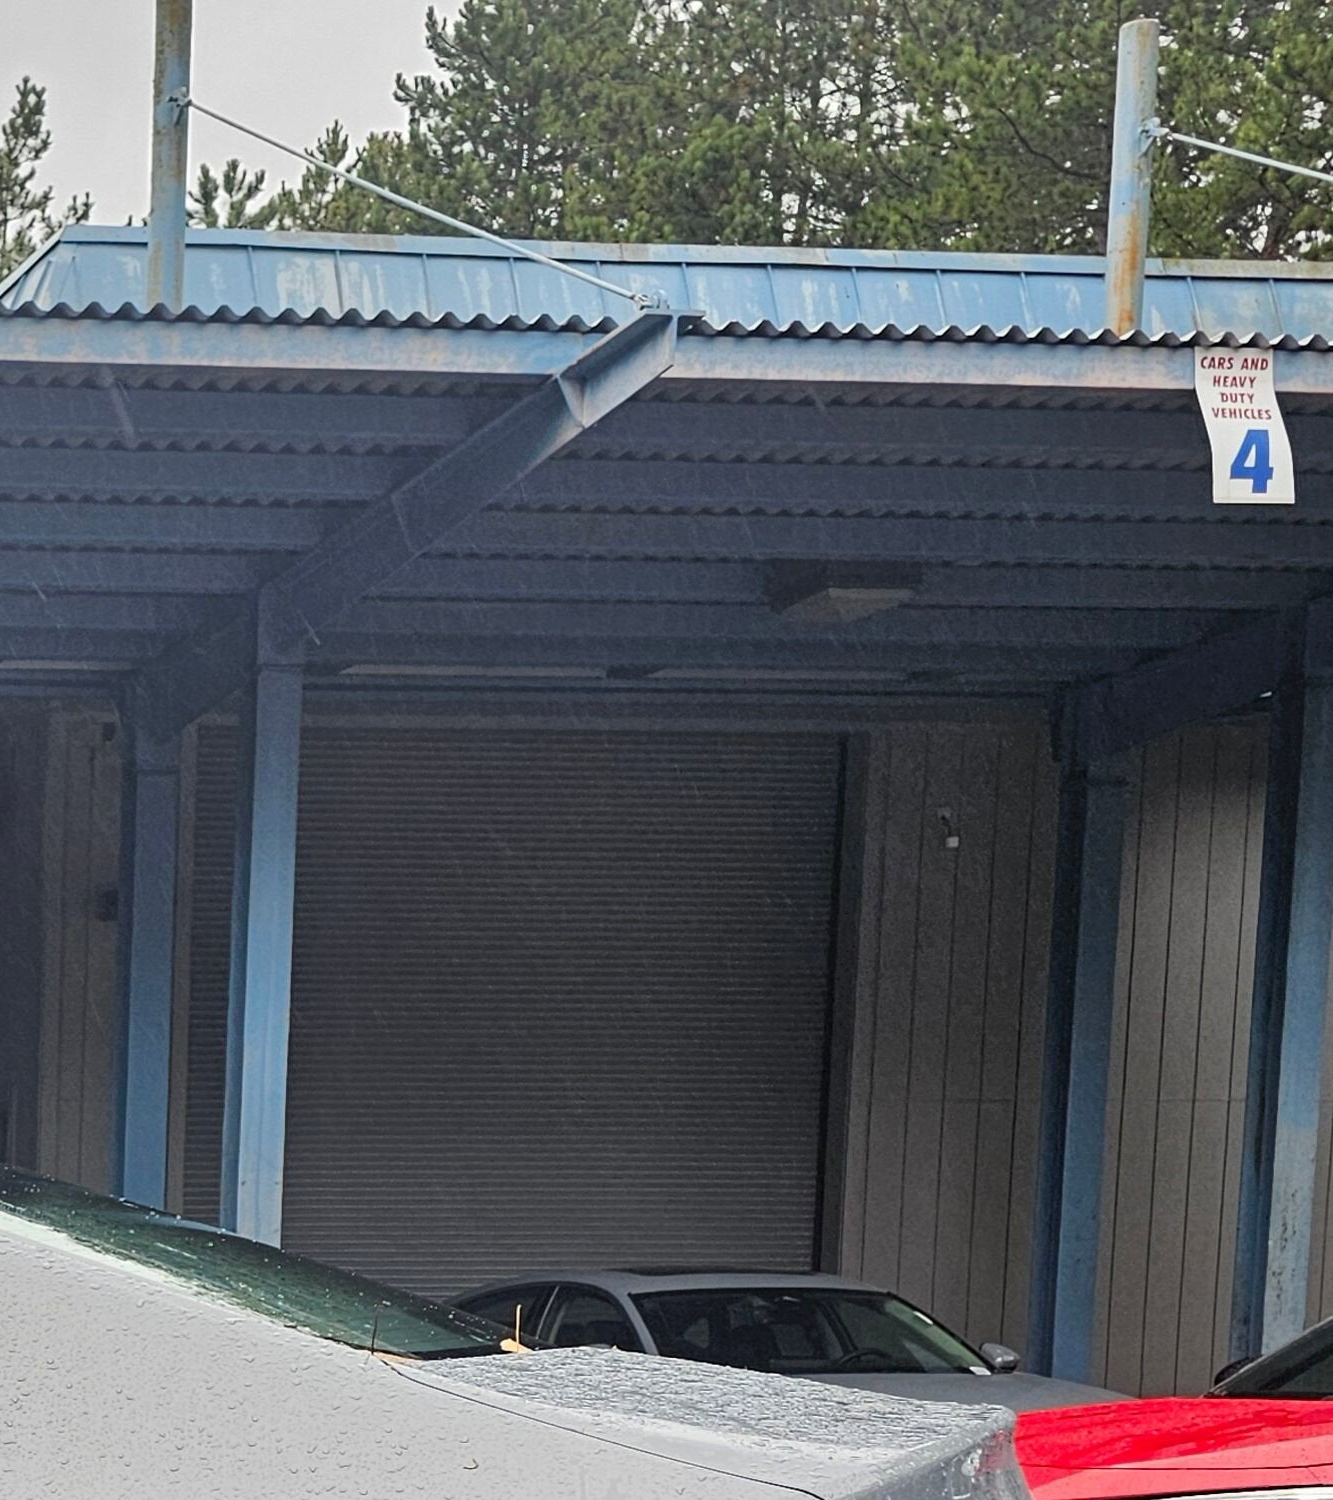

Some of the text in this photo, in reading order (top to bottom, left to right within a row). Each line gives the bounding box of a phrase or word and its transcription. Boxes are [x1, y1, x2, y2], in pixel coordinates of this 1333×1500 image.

[1200, 356, 1269, 371] CARS AND
[1212, 375, 1257, 389] HEAVY
[1220, 392, 1255, 404] DUTY
[1211, 407, 1272, 420] VEHICLES
[1229, 429, 1274, 494] 4
